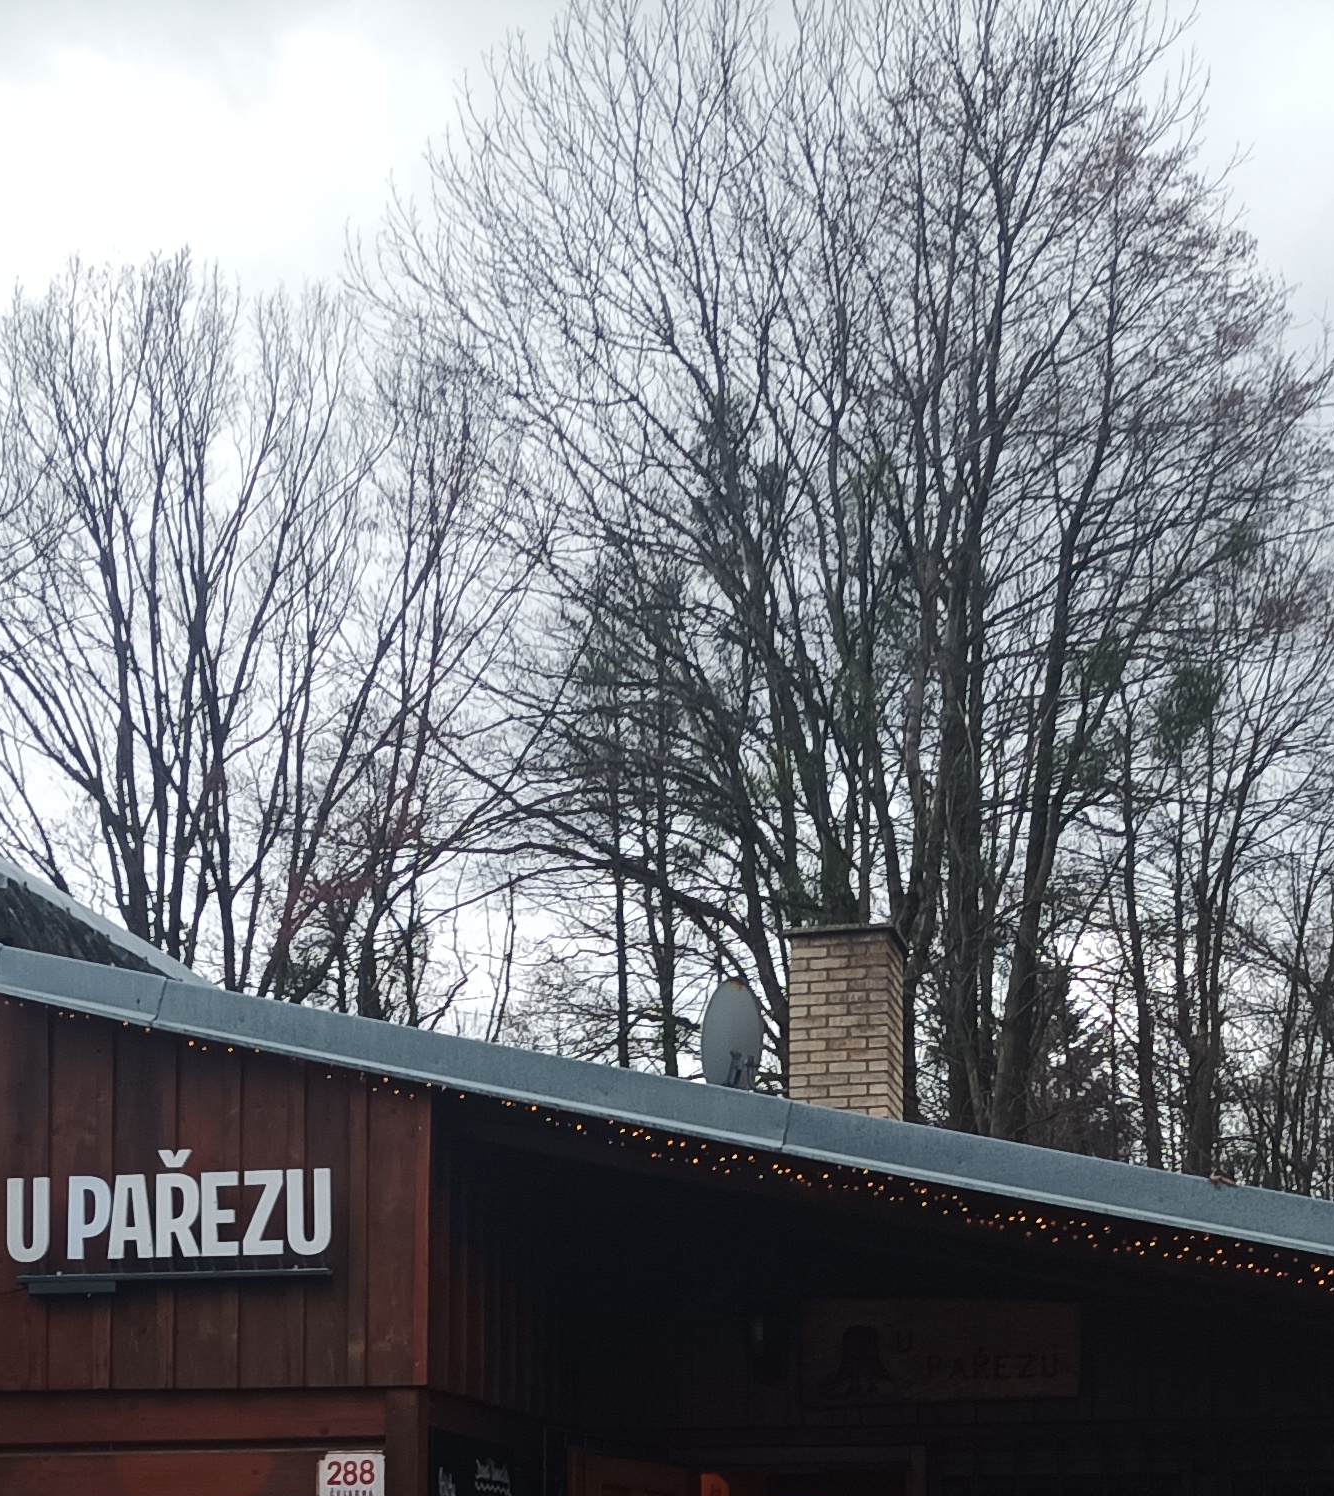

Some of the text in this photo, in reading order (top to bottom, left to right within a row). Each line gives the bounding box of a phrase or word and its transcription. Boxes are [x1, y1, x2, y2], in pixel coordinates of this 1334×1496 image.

[6, 1149, 332, 1263] U PAŘEZU
[327, 1459, 375, 1486] 288
